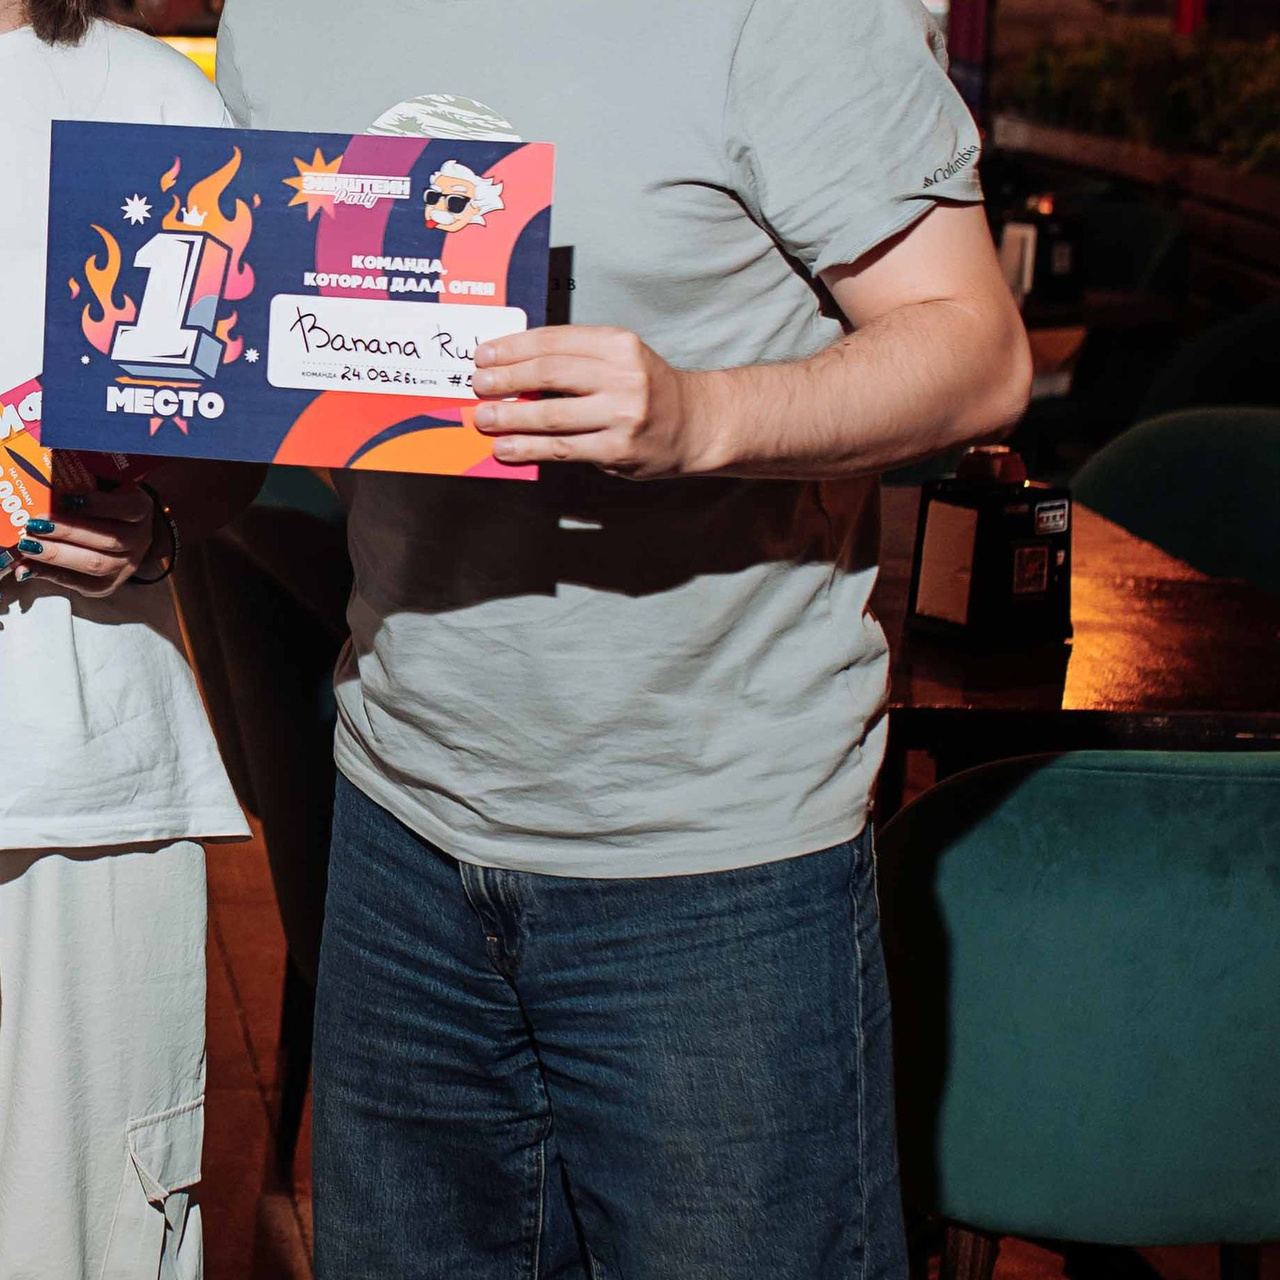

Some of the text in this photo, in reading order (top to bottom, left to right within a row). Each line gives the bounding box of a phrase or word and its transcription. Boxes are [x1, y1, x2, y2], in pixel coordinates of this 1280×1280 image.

[933, 144, 980, 184] Columbia
[334, 188, 378, 208] Party
[351, 254, 448, 274] КОМАНДА,
[303, 272, 388, 290] КОТОРАЯ
[390, 277, 446, 293] ДАЛА
[111, 230, 206, 364] 1
[290, 306, 421, 359] Banana
[301, 371, 337, 379] КОМАНДА
[106, 385, 225, 420] МЕСТО
